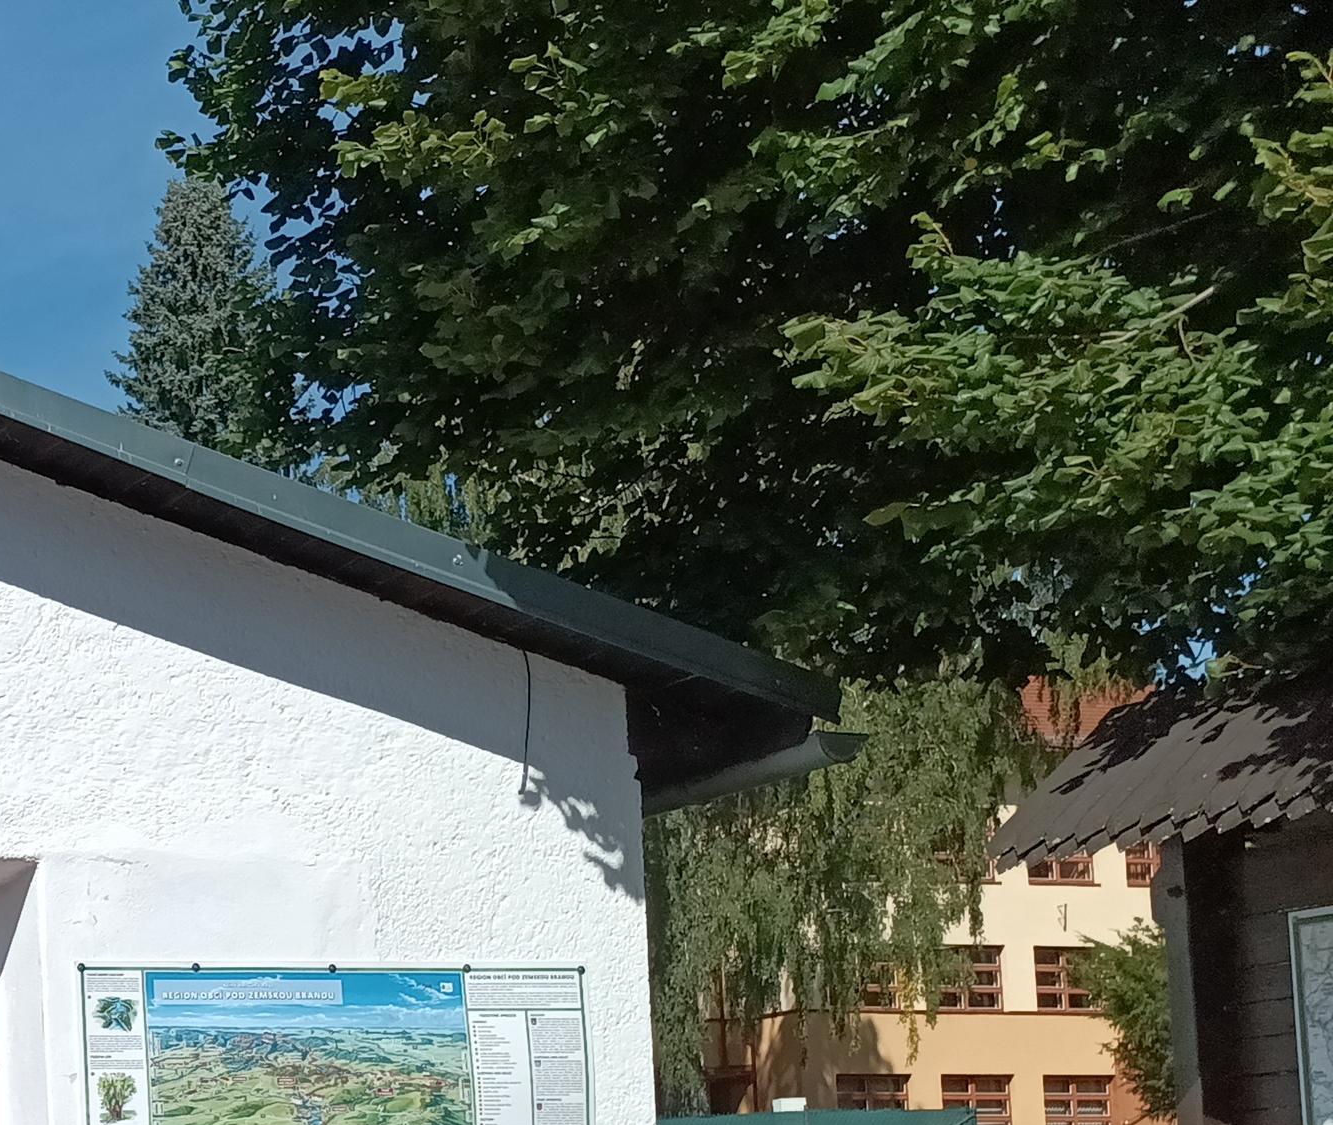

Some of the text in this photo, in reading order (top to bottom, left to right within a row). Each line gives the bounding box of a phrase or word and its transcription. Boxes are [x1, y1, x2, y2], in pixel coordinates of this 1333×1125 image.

[162, 991, 197, 1000] REGION
[225, 991, 245, 1000] POD
[248, 991, 293, 1000] ZEMSKOU
[294, 991, 334, 1000] BRANOU
